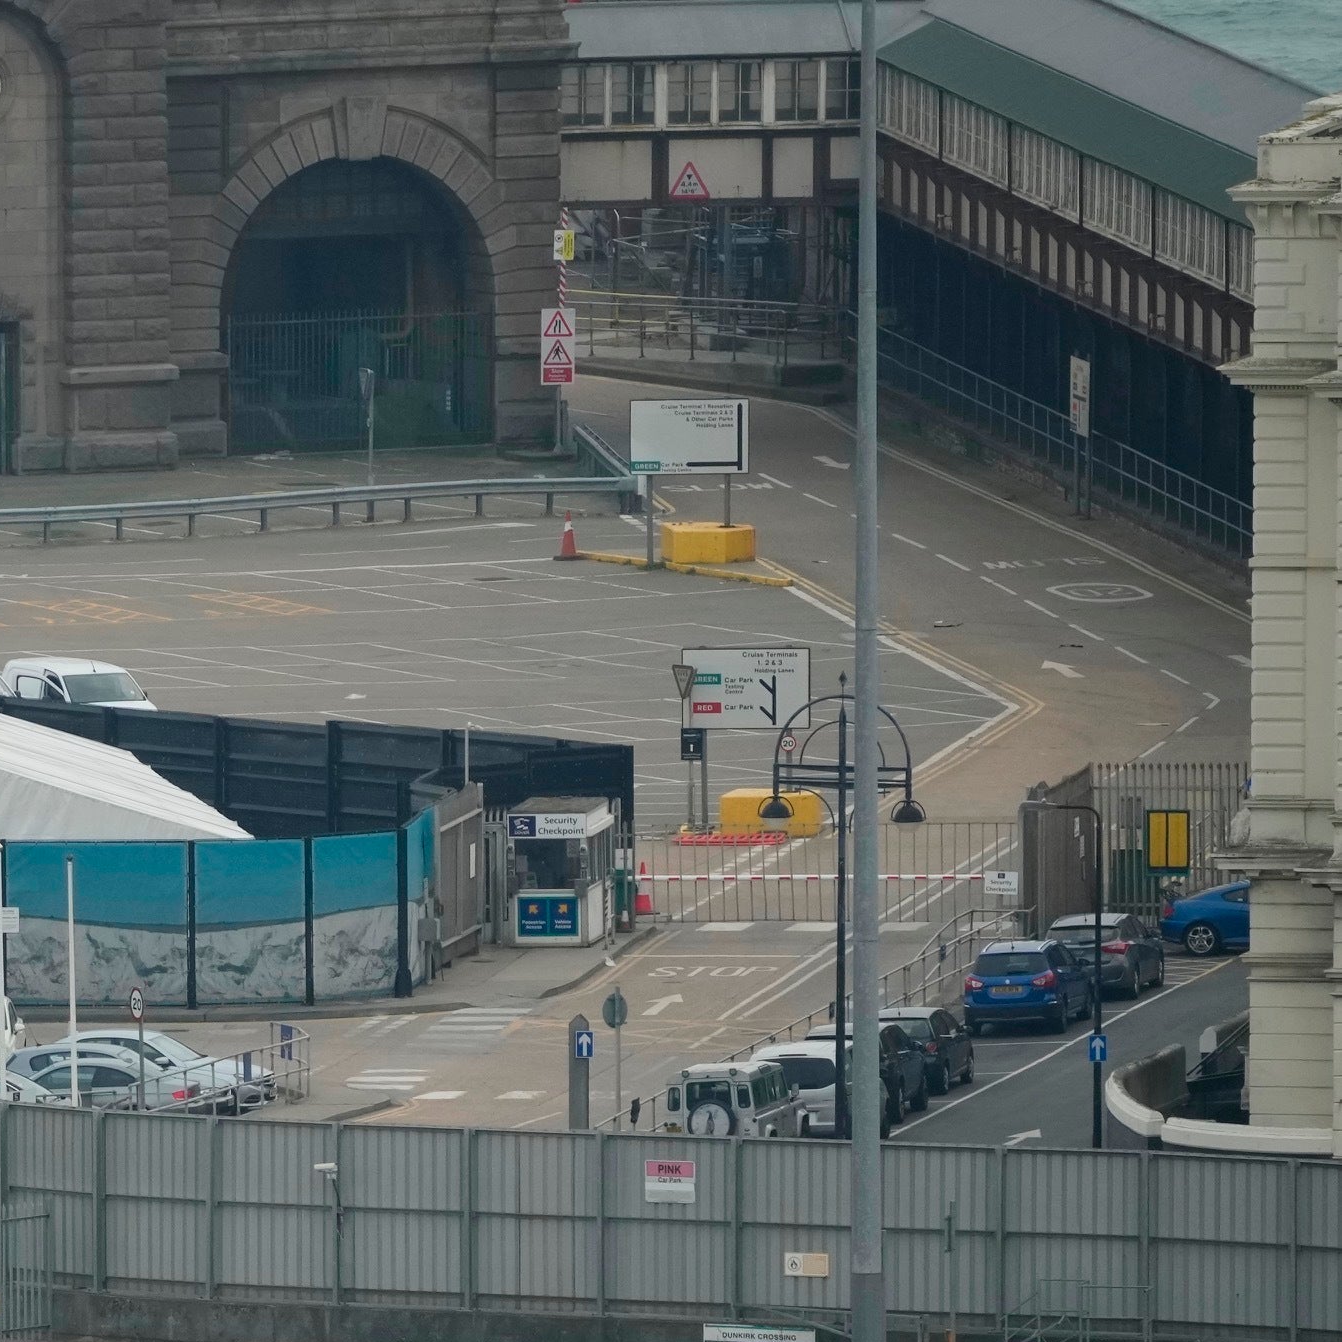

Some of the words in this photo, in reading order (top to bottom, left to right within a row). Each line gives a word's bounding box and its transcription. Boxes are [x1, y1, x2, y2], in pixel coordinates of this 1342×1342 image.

[544, 816, 578, 827] Security
[537, 826, 585, 837] Checkpoint
[986, 885, 1017, 893] Checkpoint
[648, 966, 778, 977] STOP
[132, 997, 142, 1011] 20
[657, 1164, 682, 1175] PINK
[721, 1331, 756, 1341] DUNKIRK
[757, 1332, 797, 1342] CROSSING
